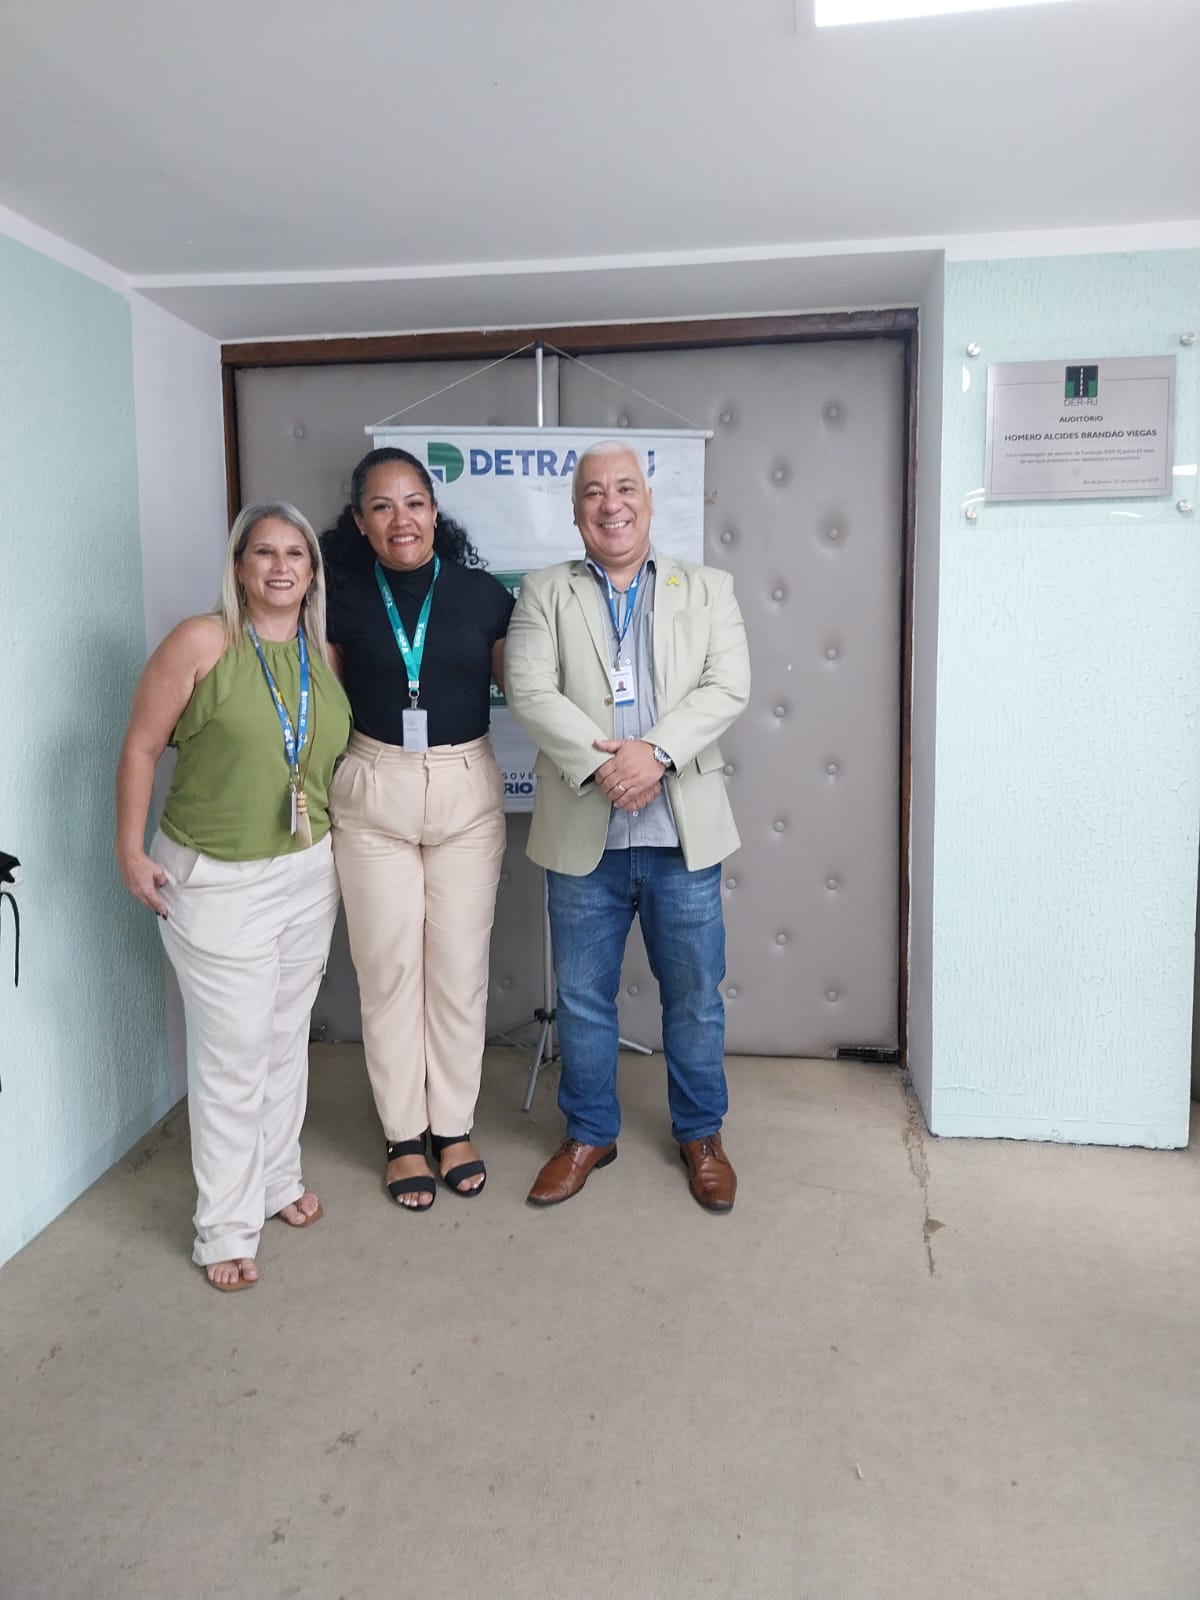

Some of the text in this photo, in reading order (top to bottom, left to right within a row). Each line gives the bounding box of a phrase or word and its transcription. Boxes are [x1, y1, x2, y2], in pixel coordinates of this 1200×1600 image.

[1063, 398, 1098, 407] DER-RJ
[1058, 414, 1104, 423] AUDITÓRIO
[1004, 429, 1157, 441] HOMERO ALCIDES BRANDÃO VIEGAS
[470, 449, 580, 476] DETRA
[504, 782, 533, 794] RIO
